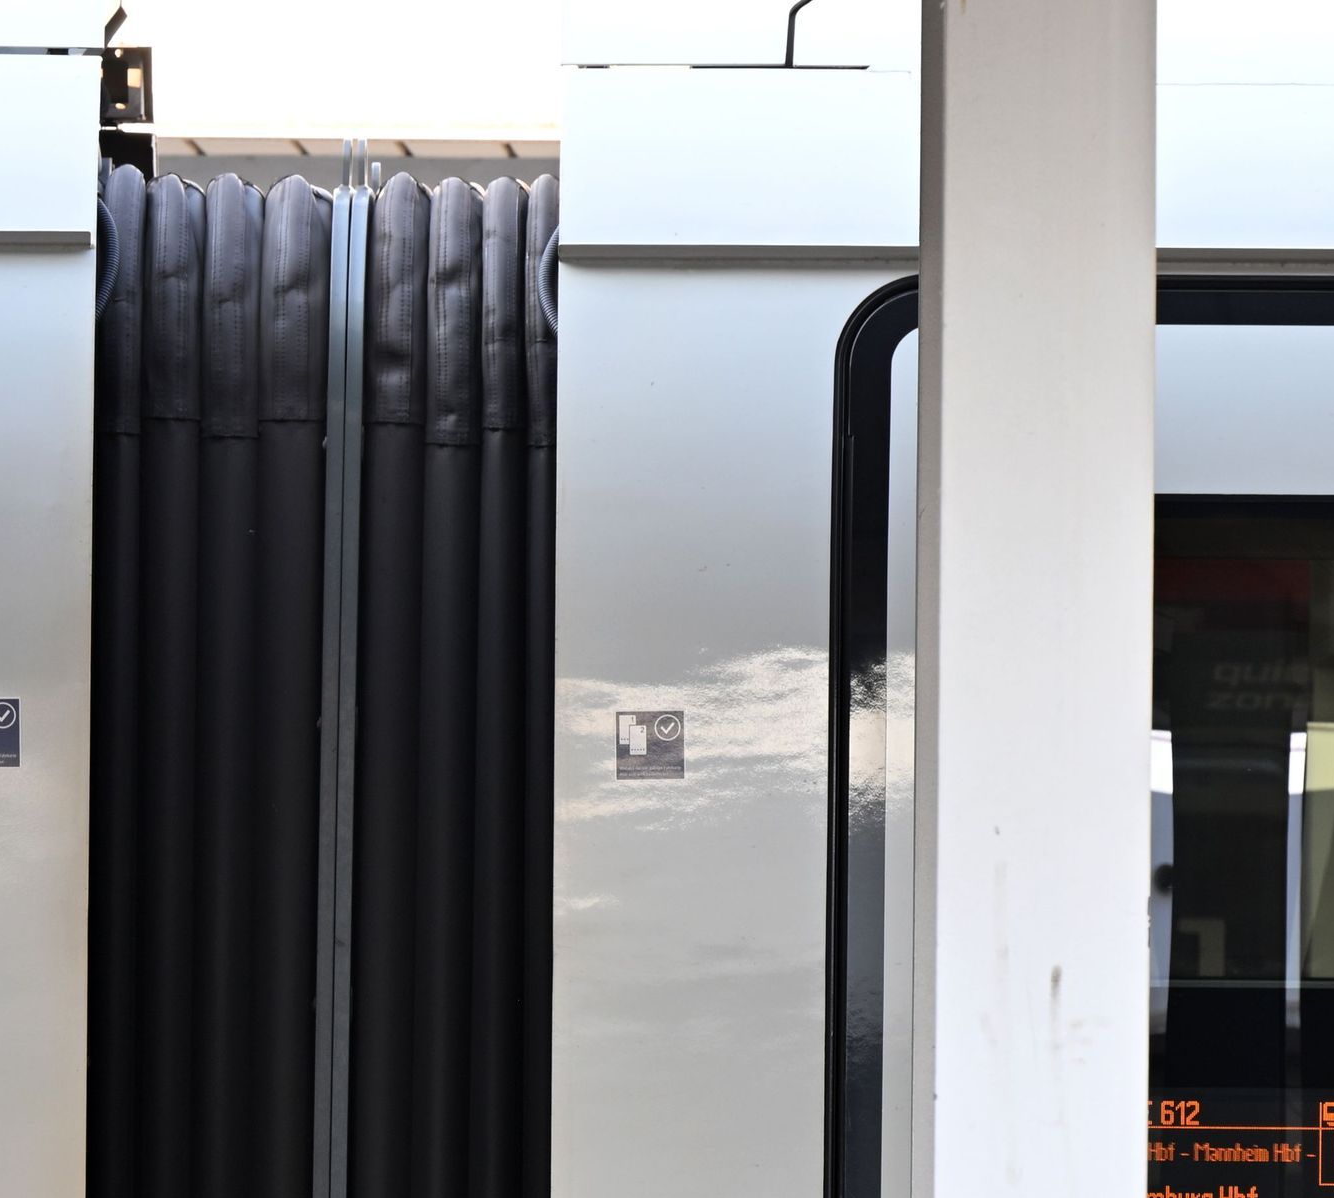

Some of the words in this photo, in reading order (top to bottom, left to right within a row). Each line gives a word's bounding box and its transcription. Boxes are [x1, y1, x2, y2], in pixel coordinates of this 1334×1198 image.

[1160, 1099, 1200, 1126] 612
[1147, 1142, 1176, 1162] Hbf
[1193, 1142, 1269, 1163] Mannheim
[1272, 1143, 1302, 1163] Hbf
